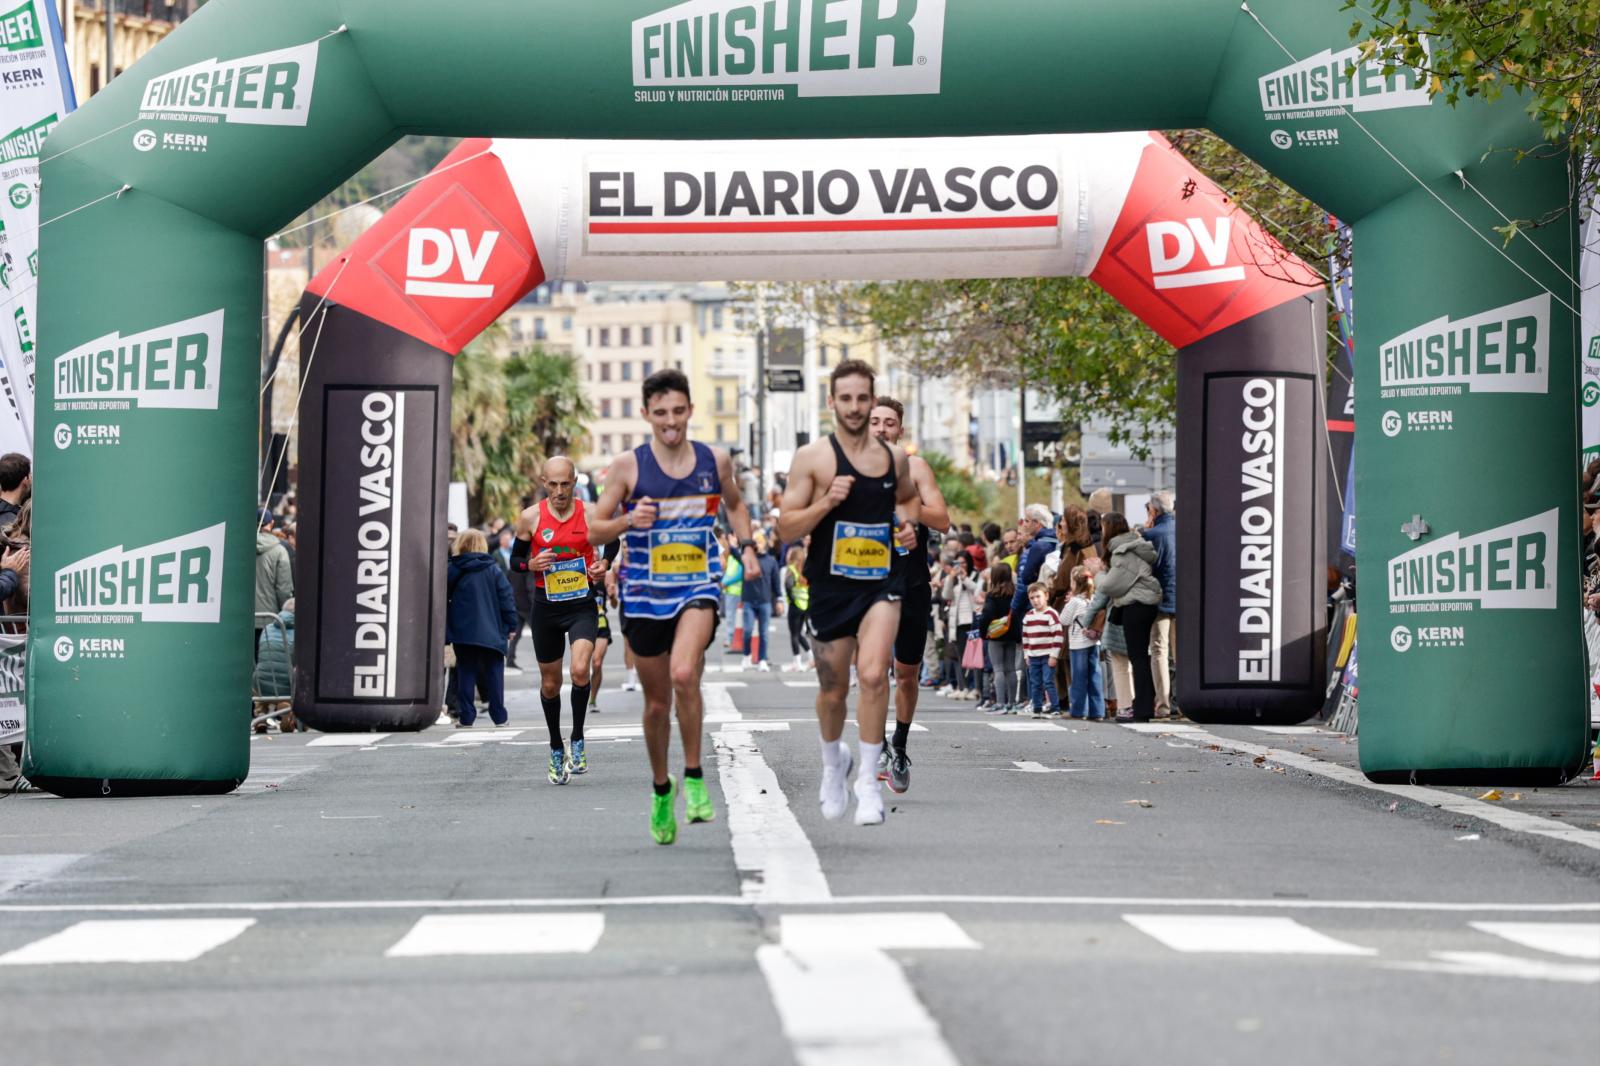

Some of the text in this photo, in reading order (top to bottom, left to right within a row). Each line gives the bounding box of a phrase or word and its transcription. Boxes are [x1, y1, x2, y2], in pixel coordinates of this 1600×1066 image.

[643, 0, 917, 79] FINISHER
[3, 67, 43, 83] KERN
[147, 61, 300, 110] FINISHER
[634, 87, 785, 102] SALUD Y NUTRICIÓN DEPORTIVA
[189, 115, 219, 124] DEPORTIVA
[163, 132, 207, 146] KERN
[1296, 129, 1339, 141] KERN
[589, 164, 1058, 216] EL DIARIO VASCO
[1145, 216, 1230, 274] DV
[406, 227, 500, 282] DV
[1384, 315, 1538, 381] FINISHER
[58, 332, 209, 394] FINISHER
[1380, 388, 1396, 398] SALUD
[1400, 386, 1428, 397] NUTRICIÓN
[1429, 386, 1462, 396] DEPORTIVA
[99, 401, 130, 410] DEPORTIVA
[1408, 411, 1453, 424] KERN
[77, 425, 120, 437] KERN
[1239, 378, 1274, 681] EL DIARIO VASCO
[353, 392, 394, 697] EL DIARIO VASCO
[661, 554, 703, 562] BASTIEN
[845, 548, 885, 557] ALVARO
[1393, 531, 1547, 597] FINISHER
[59, 546, 211, 607] FINISHER
[557, 577, 579, 585] TASIO
[1389, 605, 1405, 614] SALUD
[1410, 602, 1440, 612] NUTRICIÓN
[1440, 602, 1473, 611] DEPORTIVA
[102, 615, 134, 624] DEPORTIVA
[1418, 627, 1464, 640] KERN
[79, 639, 124, 651] KERN
